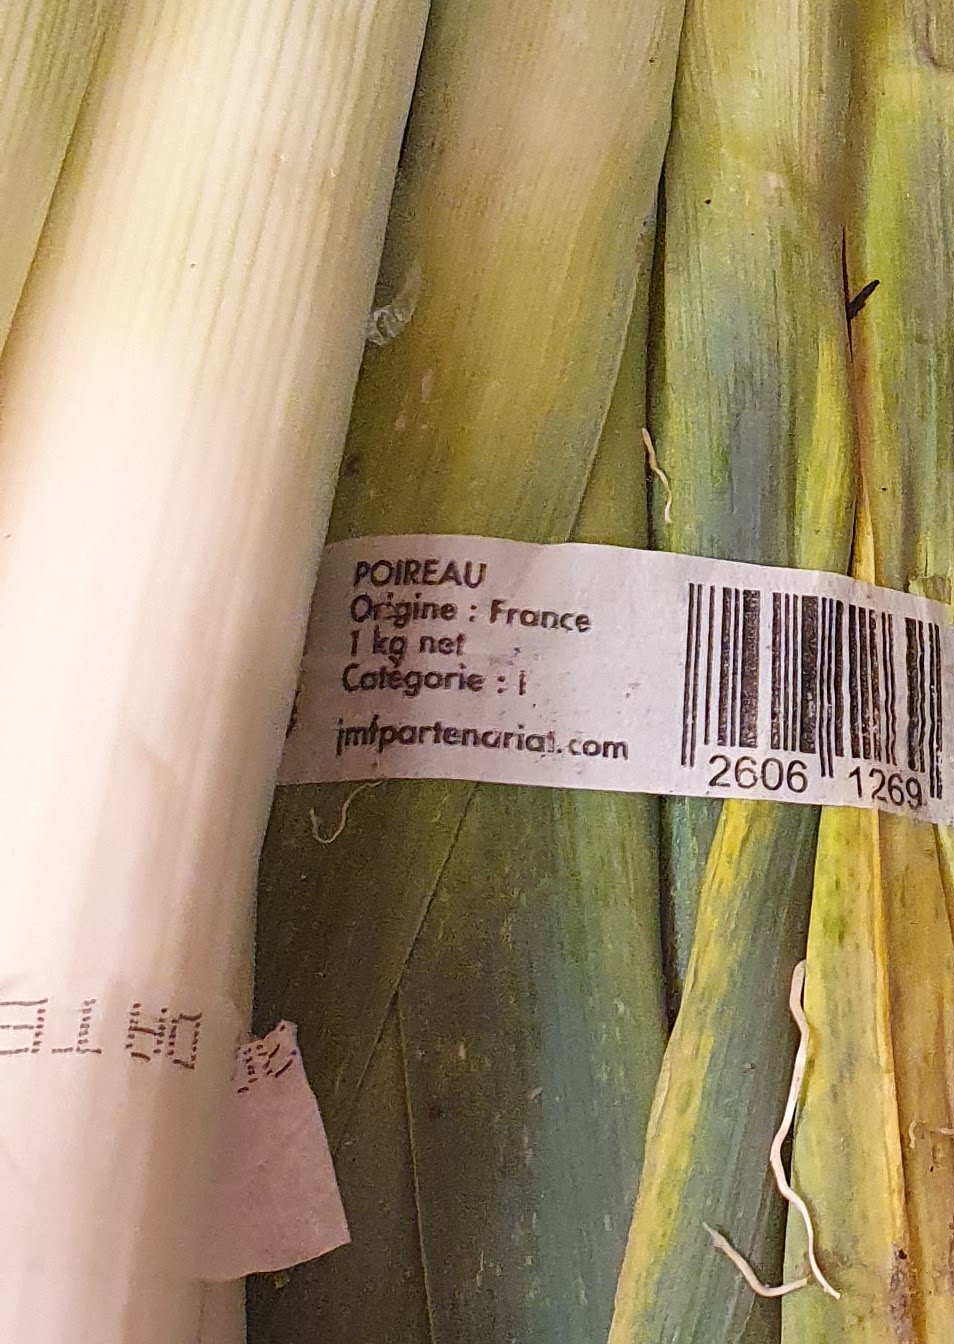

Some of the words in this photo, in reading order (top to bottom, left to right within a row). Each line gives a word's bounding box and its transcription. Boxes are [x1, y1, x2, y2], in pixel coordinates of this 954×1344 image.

[353, 558, 488, 589] POIREAU
[350, 592, 458, 629] Origine
[489, 599, 592, 634] France
[350, 629, 359, 657] 1
[372, 625, 408, 662] kg
[419, 633, 467, 657] net
[341, 660, 486, 697] Catégorie
[335, 714, 629, 761] jmfpartenariat.com
[708, 754, 808, 794] 2606
[848, 765, 926, 810] 1269
